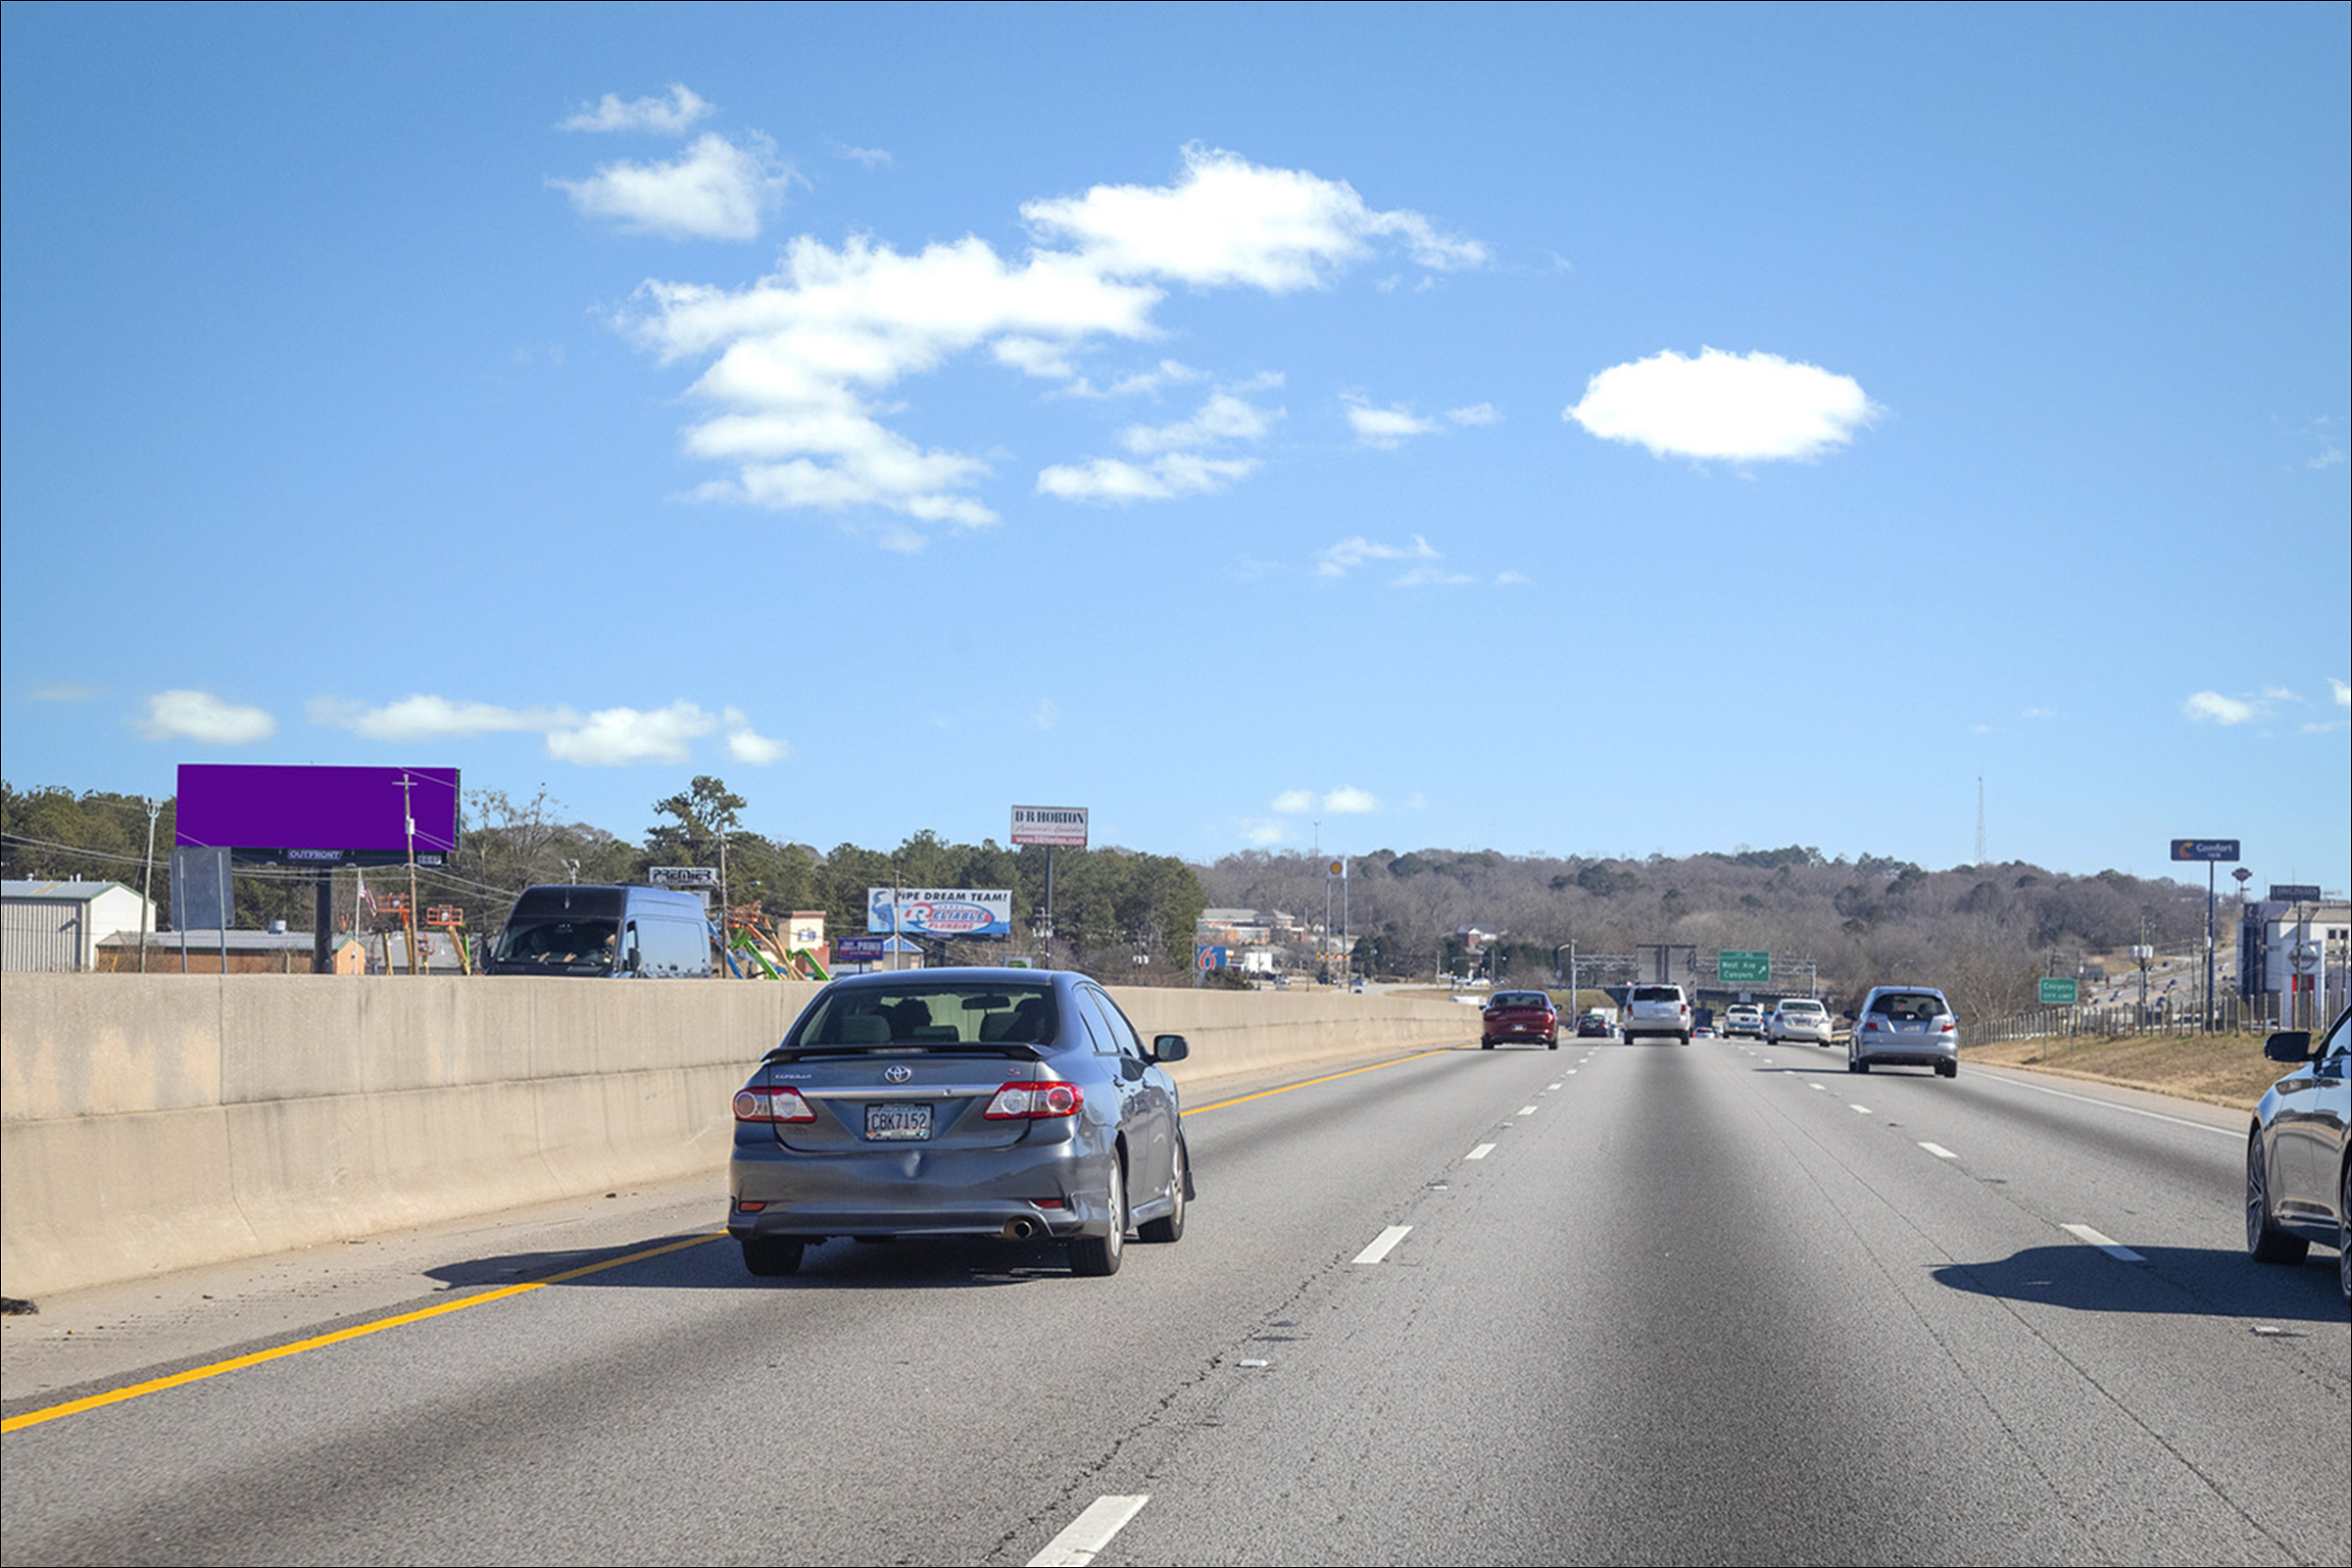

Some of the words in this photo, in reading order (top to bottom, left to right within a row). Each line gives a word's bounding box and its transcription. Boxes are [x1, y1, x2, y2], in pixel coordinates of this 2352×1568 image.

[289, 850, 341, 858] OUTFRONT
[2195, 843, 2233, 853] Comfort
[924, 892, 966, 901] DREAM
[970, 892, 1007, 902] TEAM!
[905, 903, 987, 924] RELIABLE
[1199, 946, 1217, 971] 6
[871, 1113, 928, 1130] CBK7152
